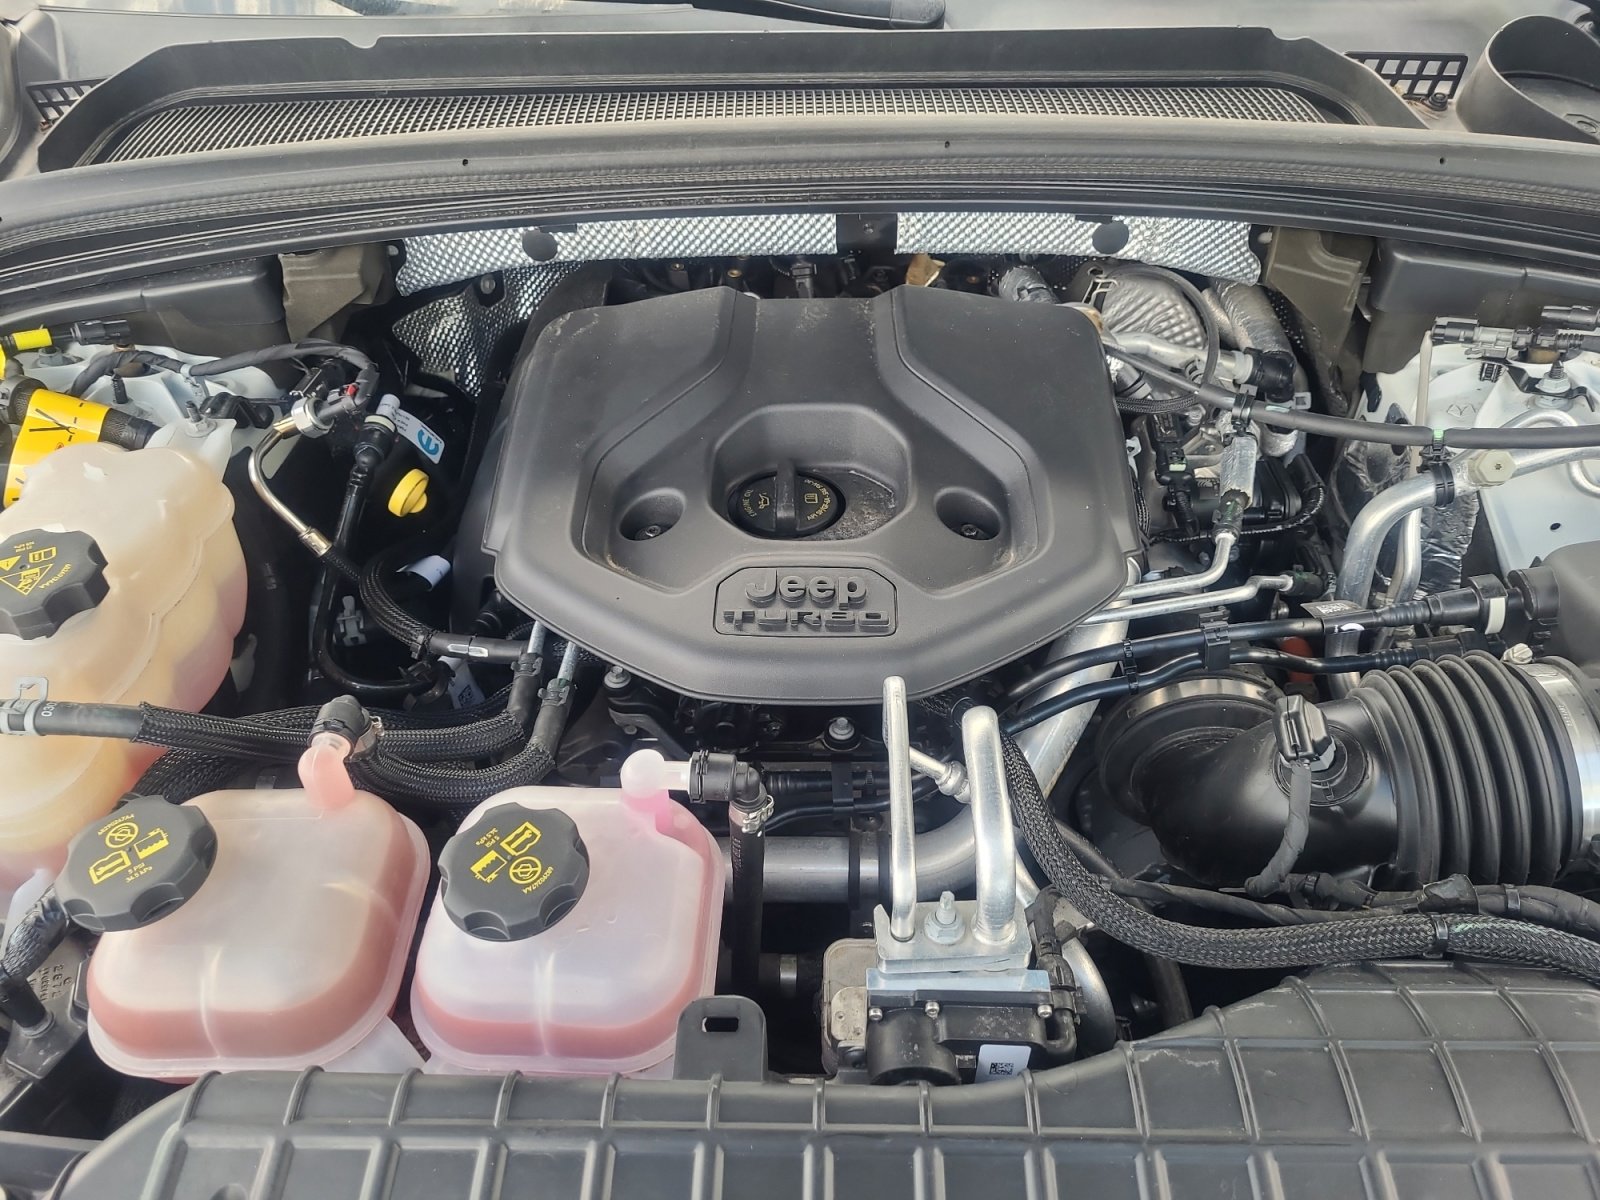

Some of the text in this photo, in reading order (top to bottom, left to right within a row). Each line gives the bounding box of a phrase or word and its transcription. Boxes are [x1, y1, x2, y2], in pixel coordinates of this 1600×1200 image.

[742, 498, 757, 517] ENGINE
[745, 568, 867, 609] Jeep
[723, 610, 890, 628] TURBO
